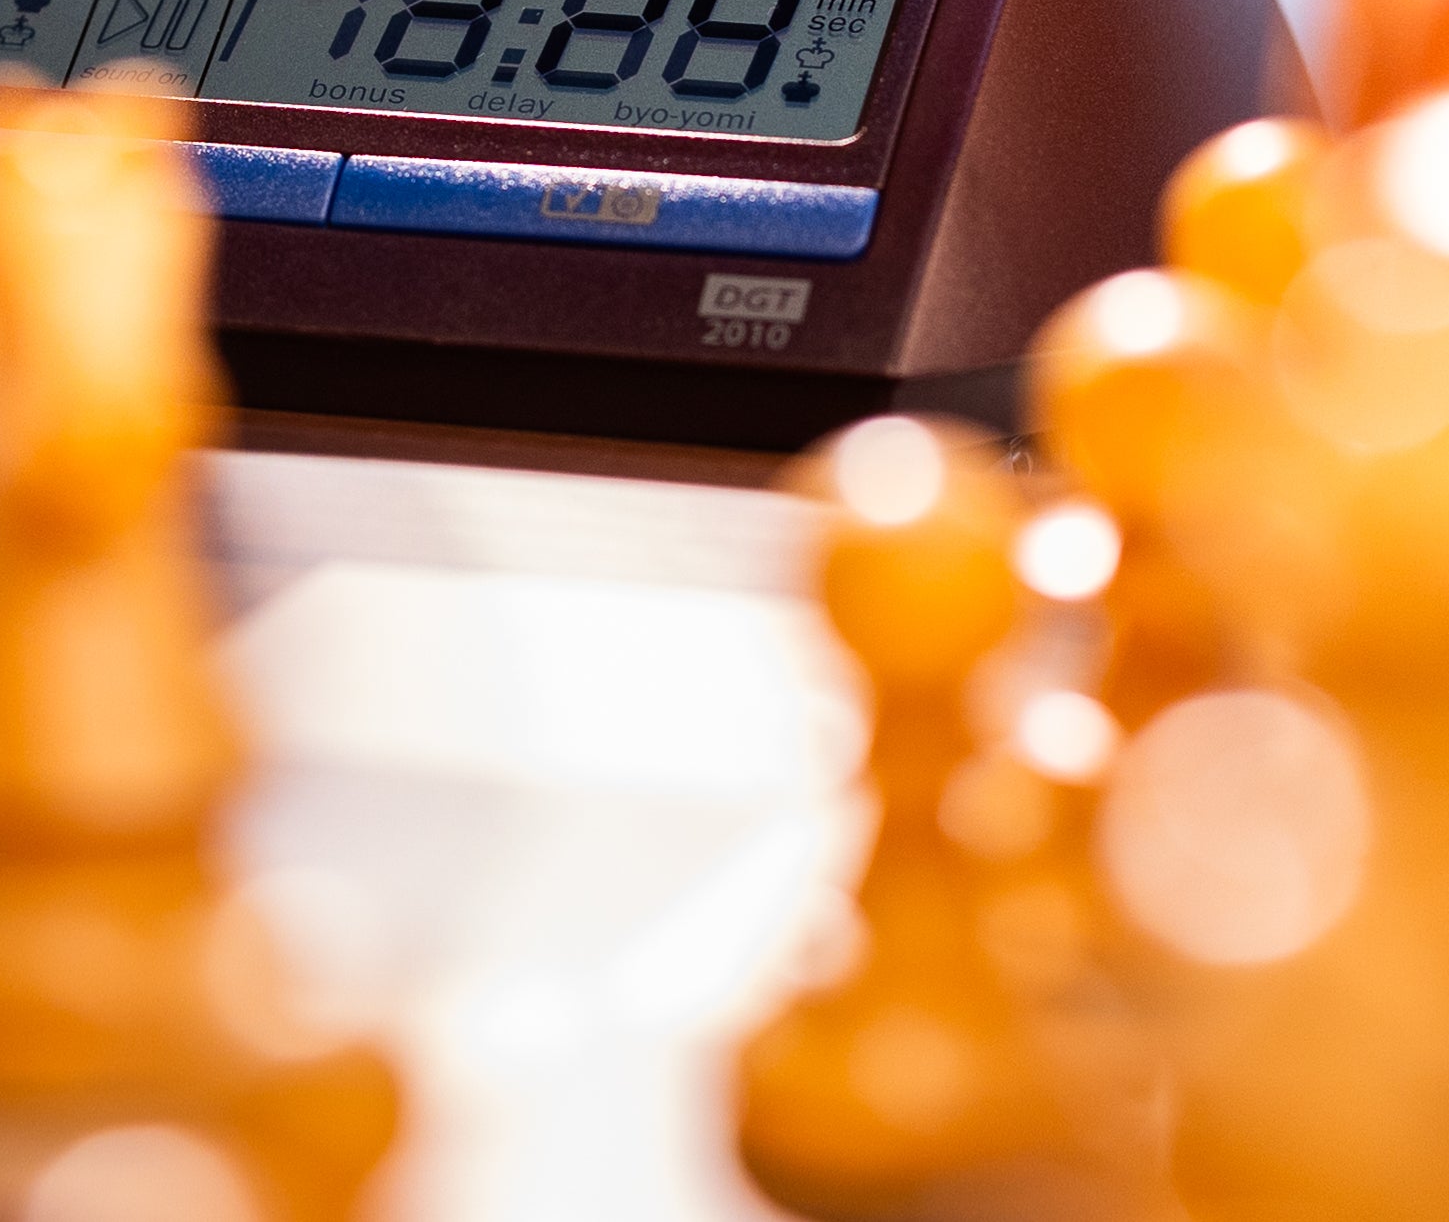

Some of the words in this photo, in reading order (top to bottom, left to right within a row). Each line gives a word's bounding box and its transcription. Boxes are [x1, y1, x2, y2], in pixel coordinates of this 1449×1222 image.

[808, 15, 866, 34] sec
[80, 66, 156, 83] sound
[158, 72, 188, 86] on
[308, 79, 406, 105] bonus
[468, 90, 554, 119] delay
[614, 100, 758, 131] byo-yomi
[714, 284, 800, 311] DGT
[702, 321, 793, 348] 2010
